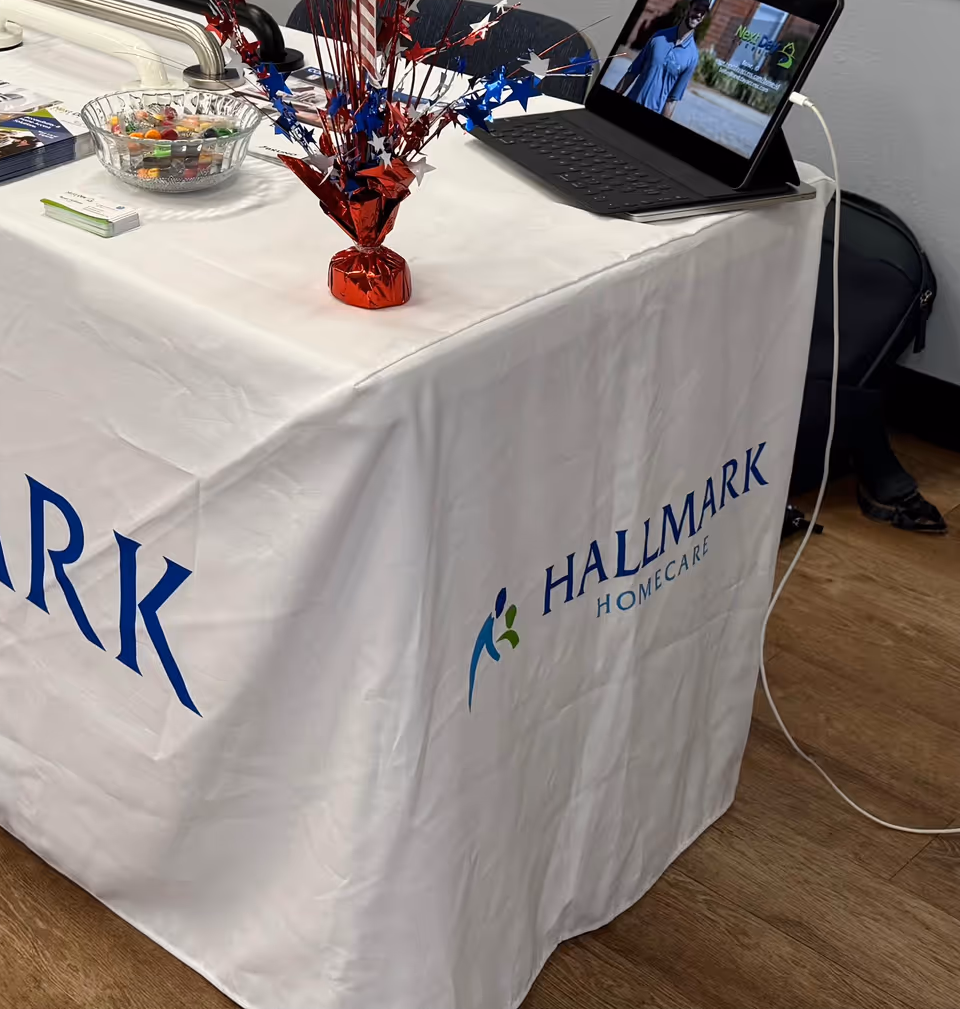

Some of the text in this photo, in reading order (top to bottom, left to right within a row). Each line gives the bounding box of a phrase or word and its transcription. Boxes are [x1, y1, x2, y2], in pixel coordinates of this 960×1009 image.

[735, 24, 760, 44] Next
[542, 441, 769, 616] HALLMARK
[596, 535, 709, 618] HOMECARE
